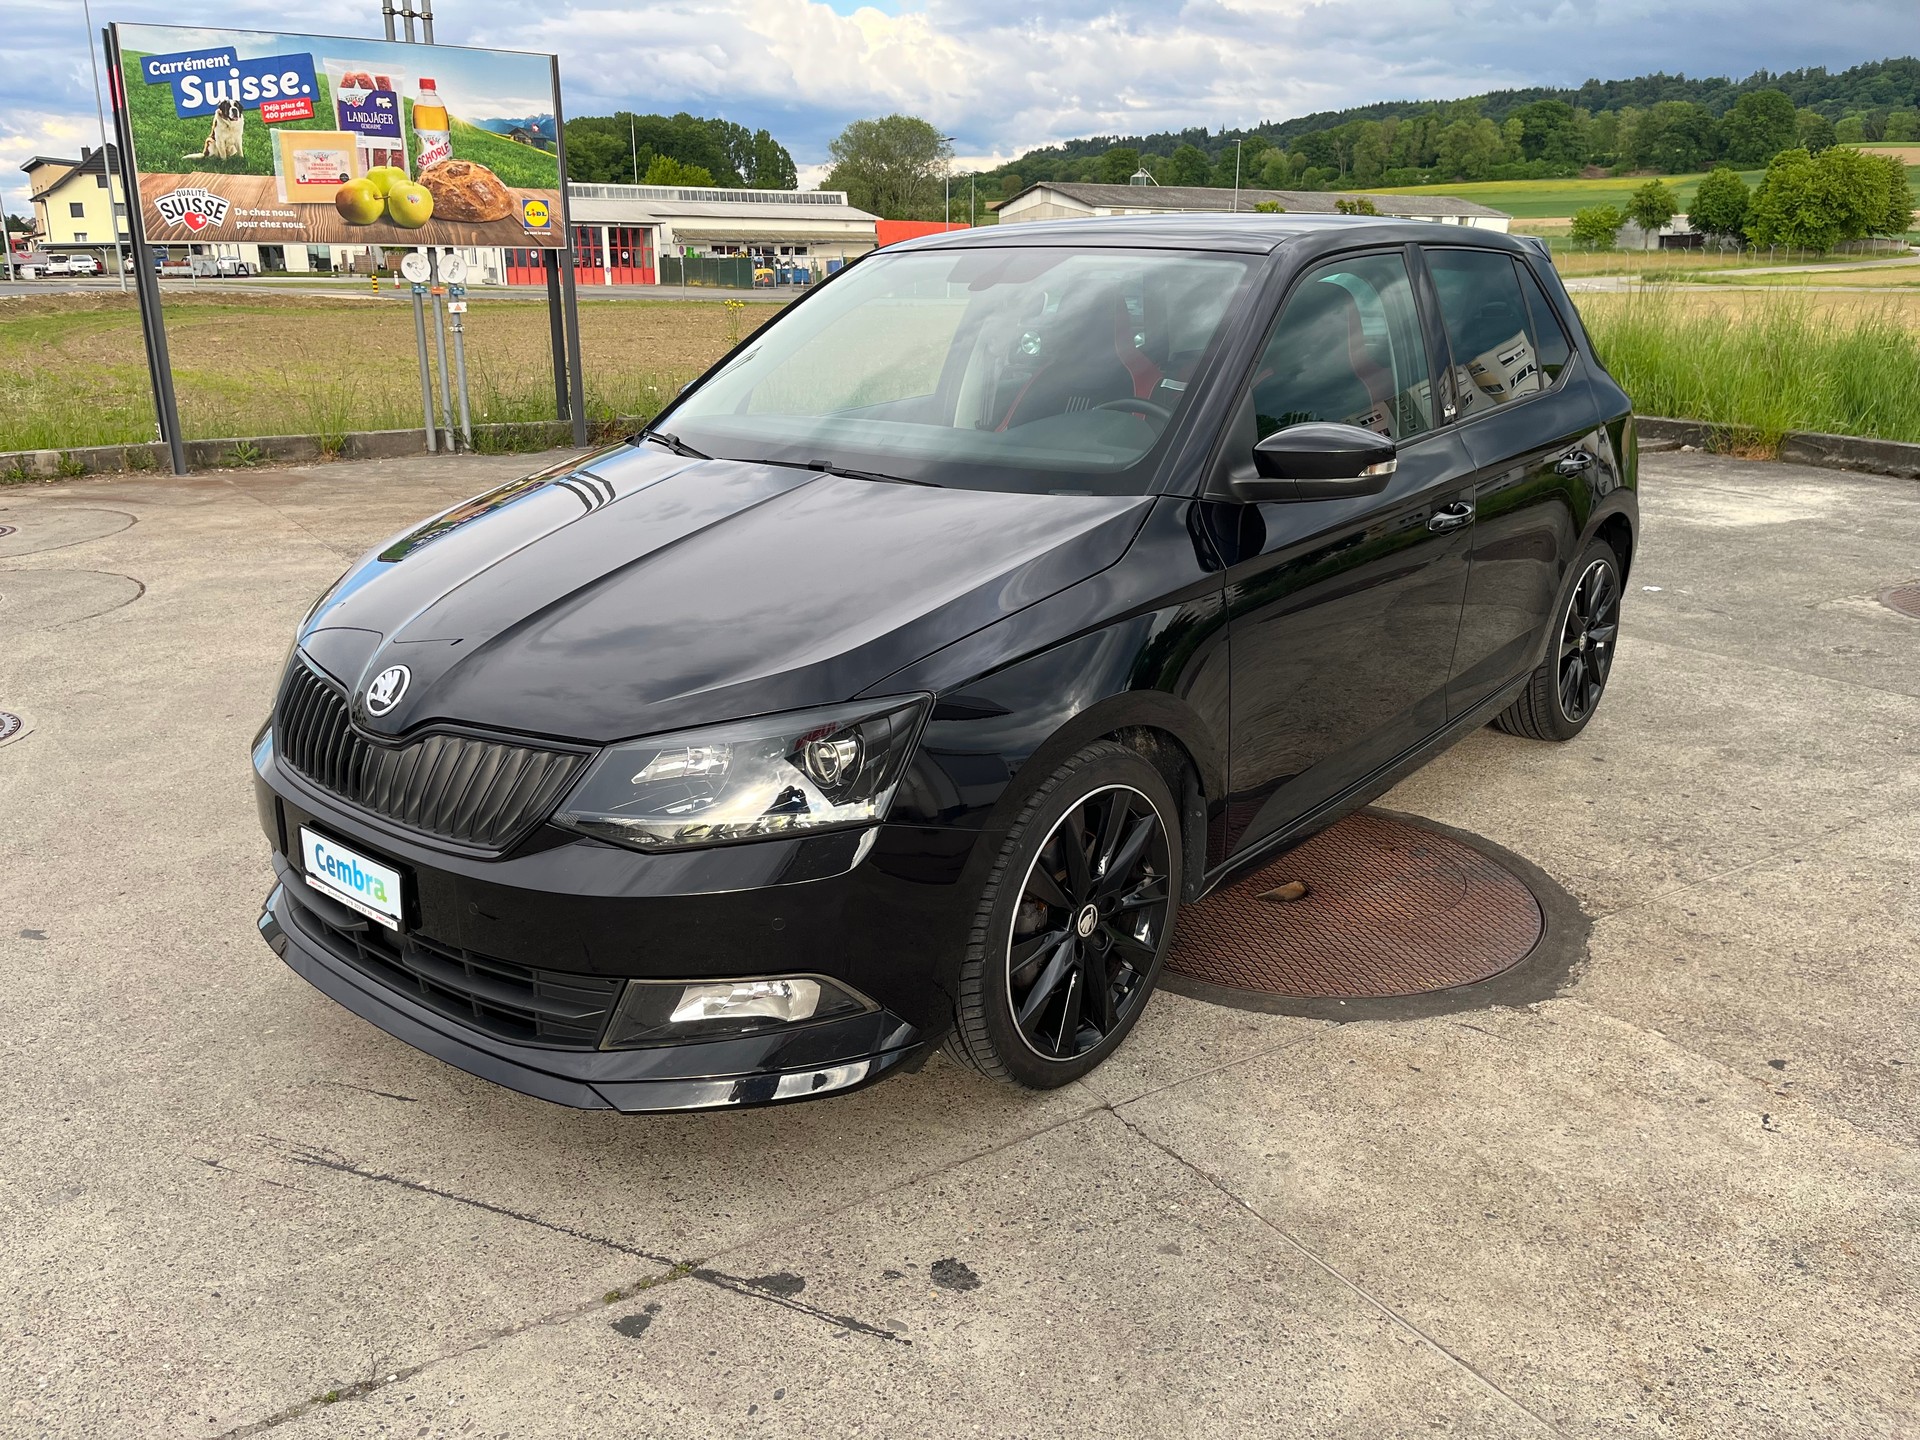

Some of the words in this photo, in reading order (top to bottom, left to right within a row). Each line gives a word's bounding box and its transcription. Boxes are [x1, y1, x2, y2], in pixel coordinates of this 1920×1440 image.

[149, 54, 230, 75] Carrément
[180, 68, 311, 108] Suisse.
[263, 104, 279, 112] Déjà
[280, 102, 295, 110] plus
[280, 109, 310, 119] produits.
[347, 111, 394, 125] LANDJÄGER
[417, 142, 449, 169] SCHORLE
[176, 189, 206, 198] QUALITÉ
[160, 198, 226, 220] SUISSE
[234, 208, 248, 216] De
[249, 208, 271, 217] chez
[271, 210, 297, 218] nous,
[526, 208, 547, 217] LIDL
[236, 221, 258, 230] pour
[259, 219, 281, 228] chez
[282, 221, 306, 229] nous.
[315, 843, 388, 903] Cembra
